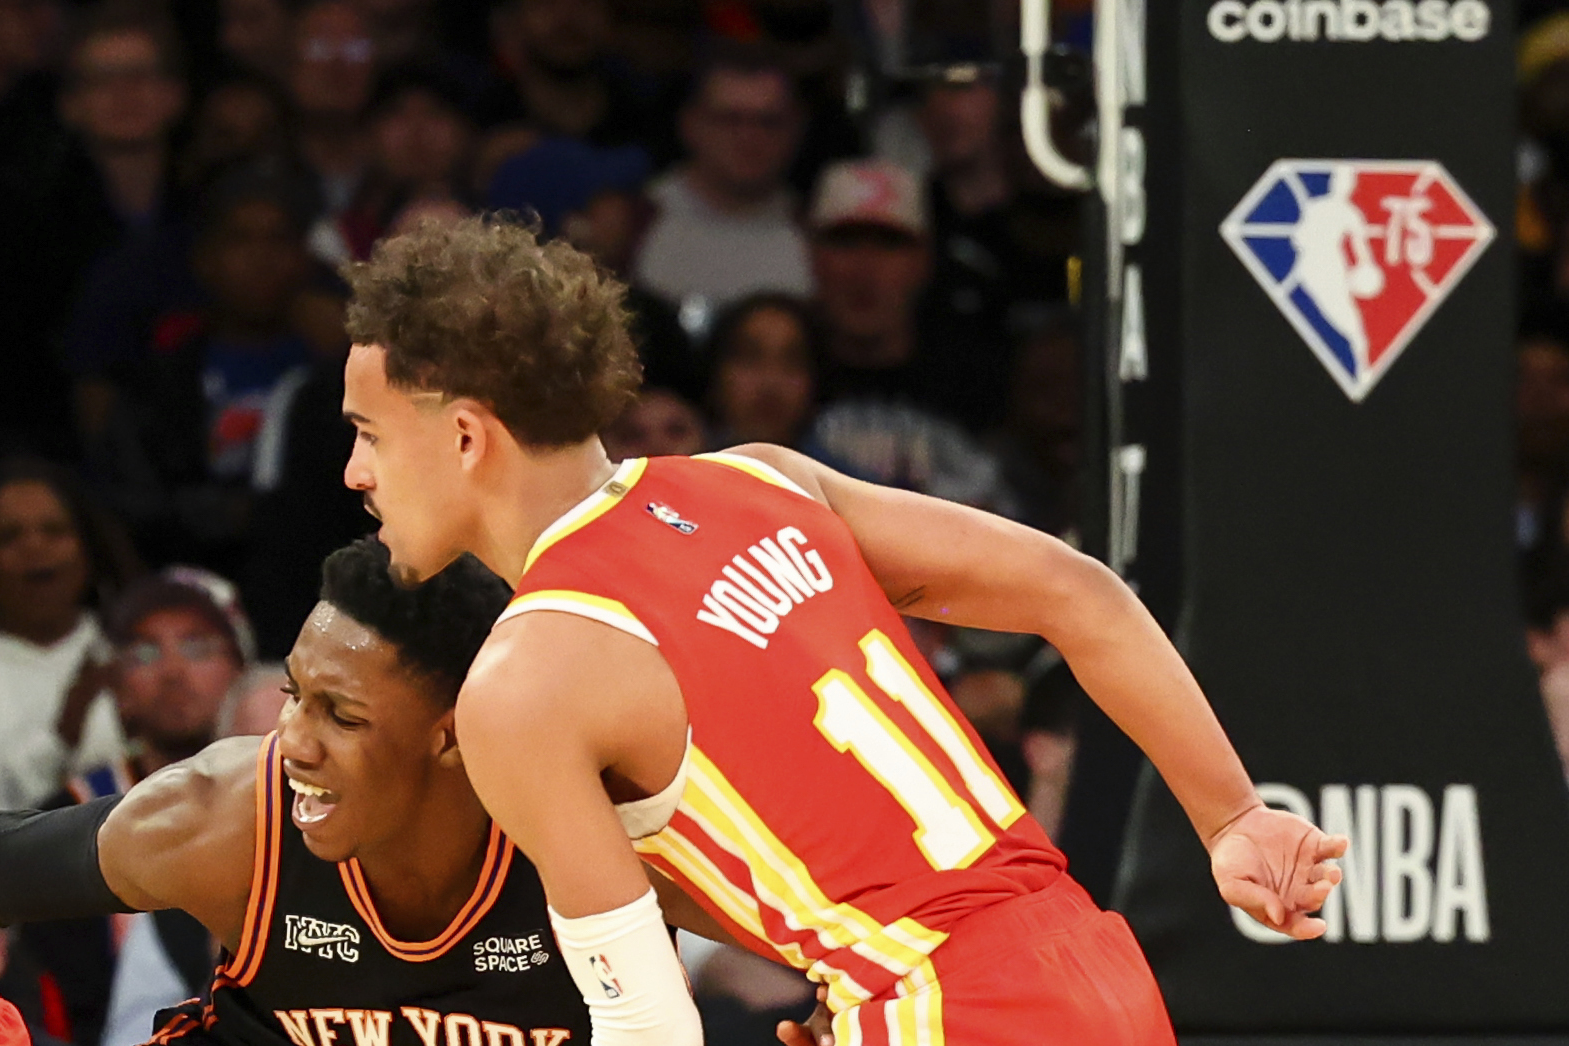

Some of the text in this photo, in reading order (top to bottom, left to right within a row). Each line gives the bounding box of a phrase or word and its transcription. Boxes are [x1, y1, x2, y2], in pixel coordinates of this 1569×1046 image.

[1207, 0, 1491, 43] coinbase
[696, 526, 834, 650] YOUNG
[811, 628, 1027, 872] 11
[472, 933, 544, 956] SQUARE
[474, 954, 532, 973] SPACE
